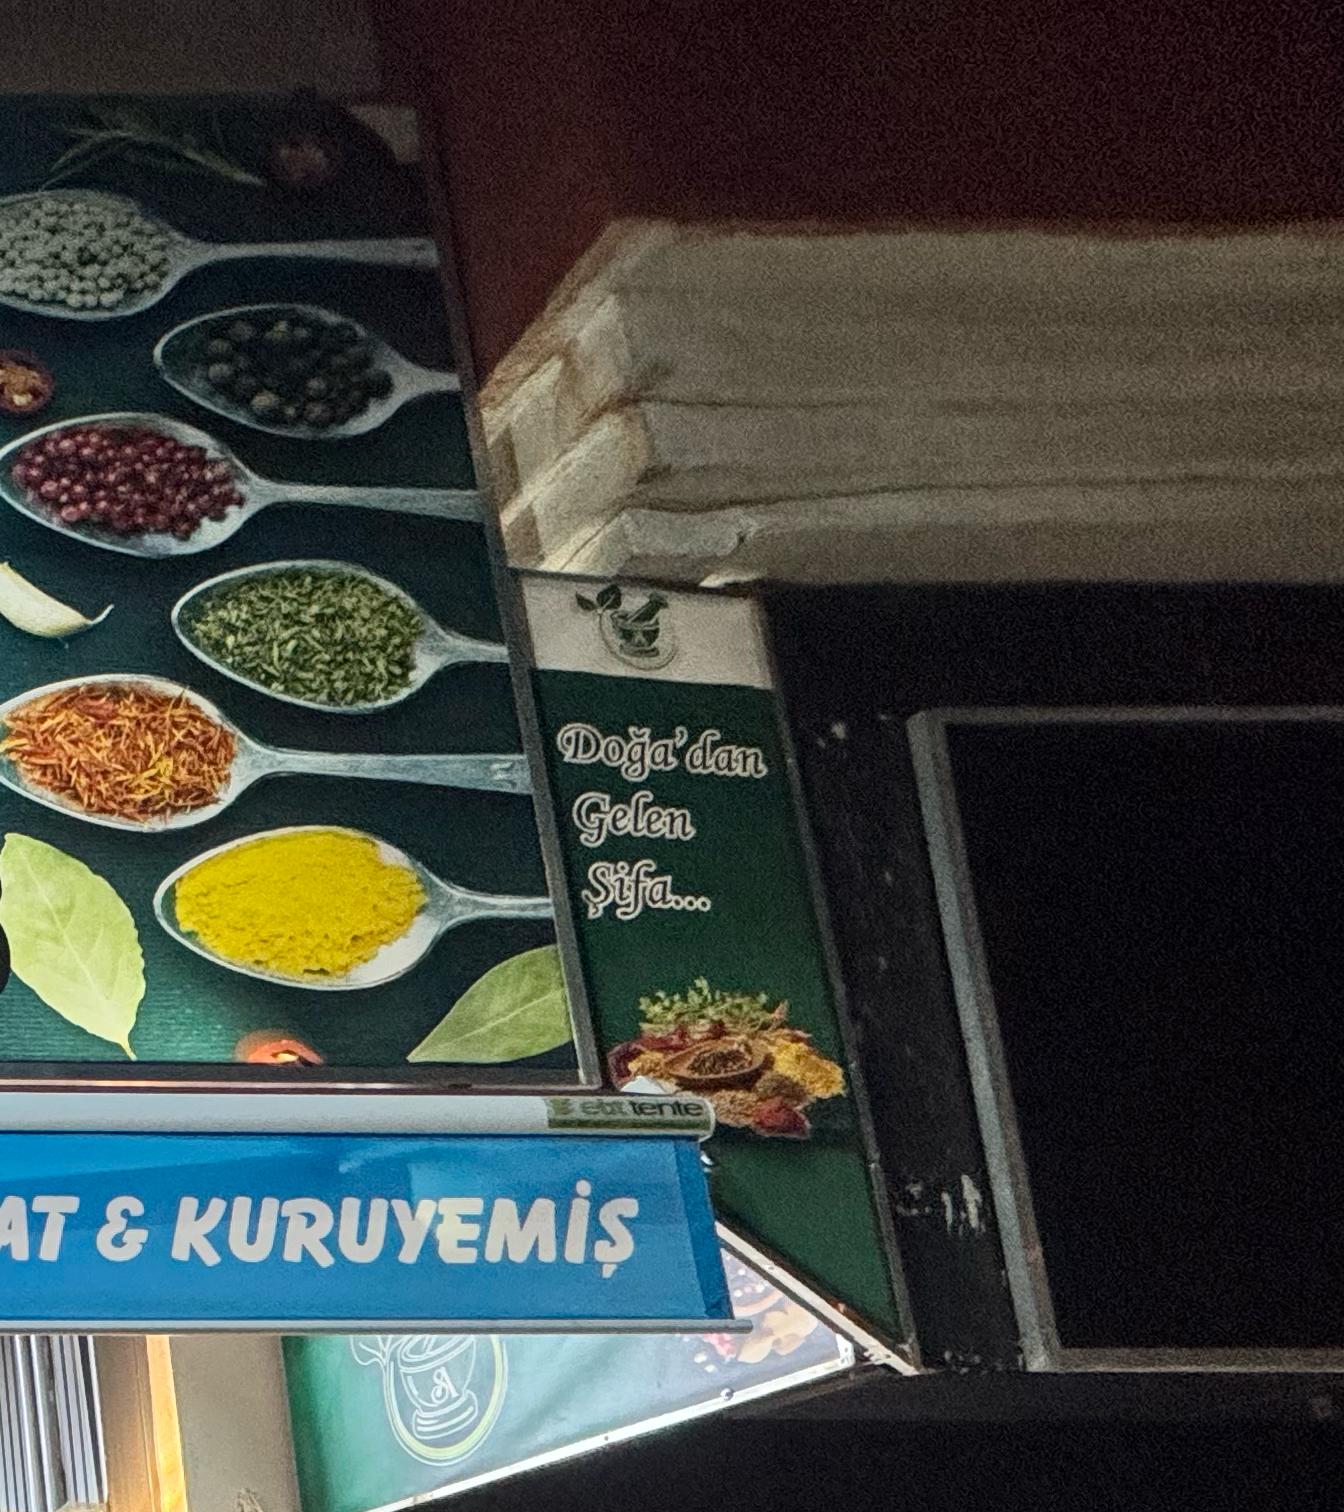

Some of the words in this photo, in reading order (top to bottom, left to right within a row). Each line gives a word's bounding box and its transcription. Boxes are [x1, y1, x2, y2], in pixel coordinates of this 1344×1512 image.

[558, 722, 768, 782] Doğa'dan
[572, 790, 696, 848] Gelen
[95, 1197, 150, 1264] &
[169, 1178, 640, 1280] KURUYEMİŞ
